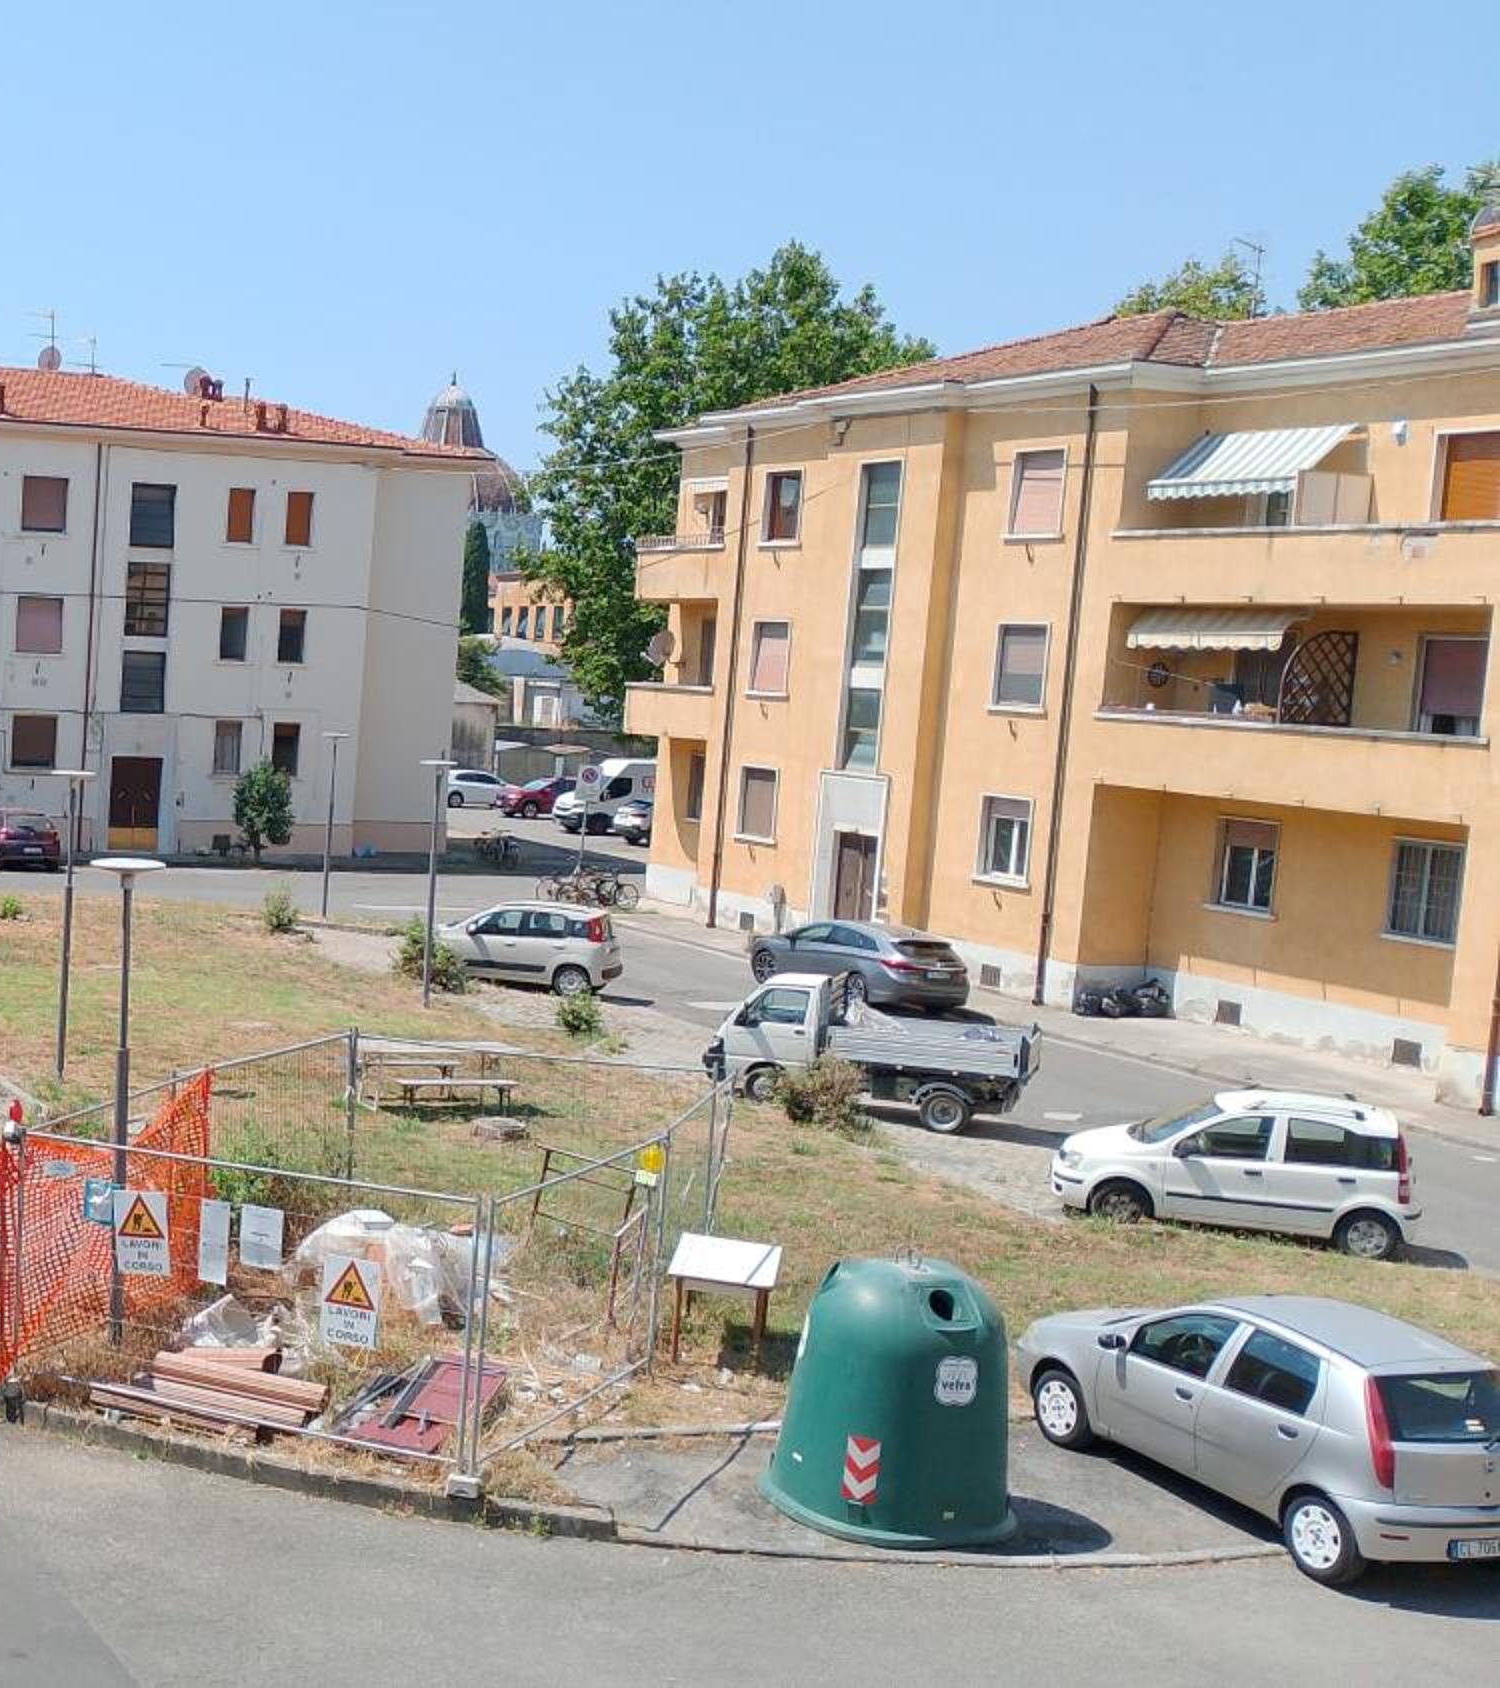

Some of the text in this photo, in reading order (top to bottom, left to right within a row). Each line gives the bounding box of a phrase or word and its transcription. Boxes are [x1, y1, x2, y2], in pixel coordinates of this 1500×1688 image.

[121, 1239, 163, 1251] LAVORI
[137, 1251, 149, 1260] IN
[123, 1261, 163, 1271] CORSO
[328, 1306, 371, 1321] LAVORI
[343, 1319, 355, 1330] IN
[327, 1328, 369, 1345] CORSO
